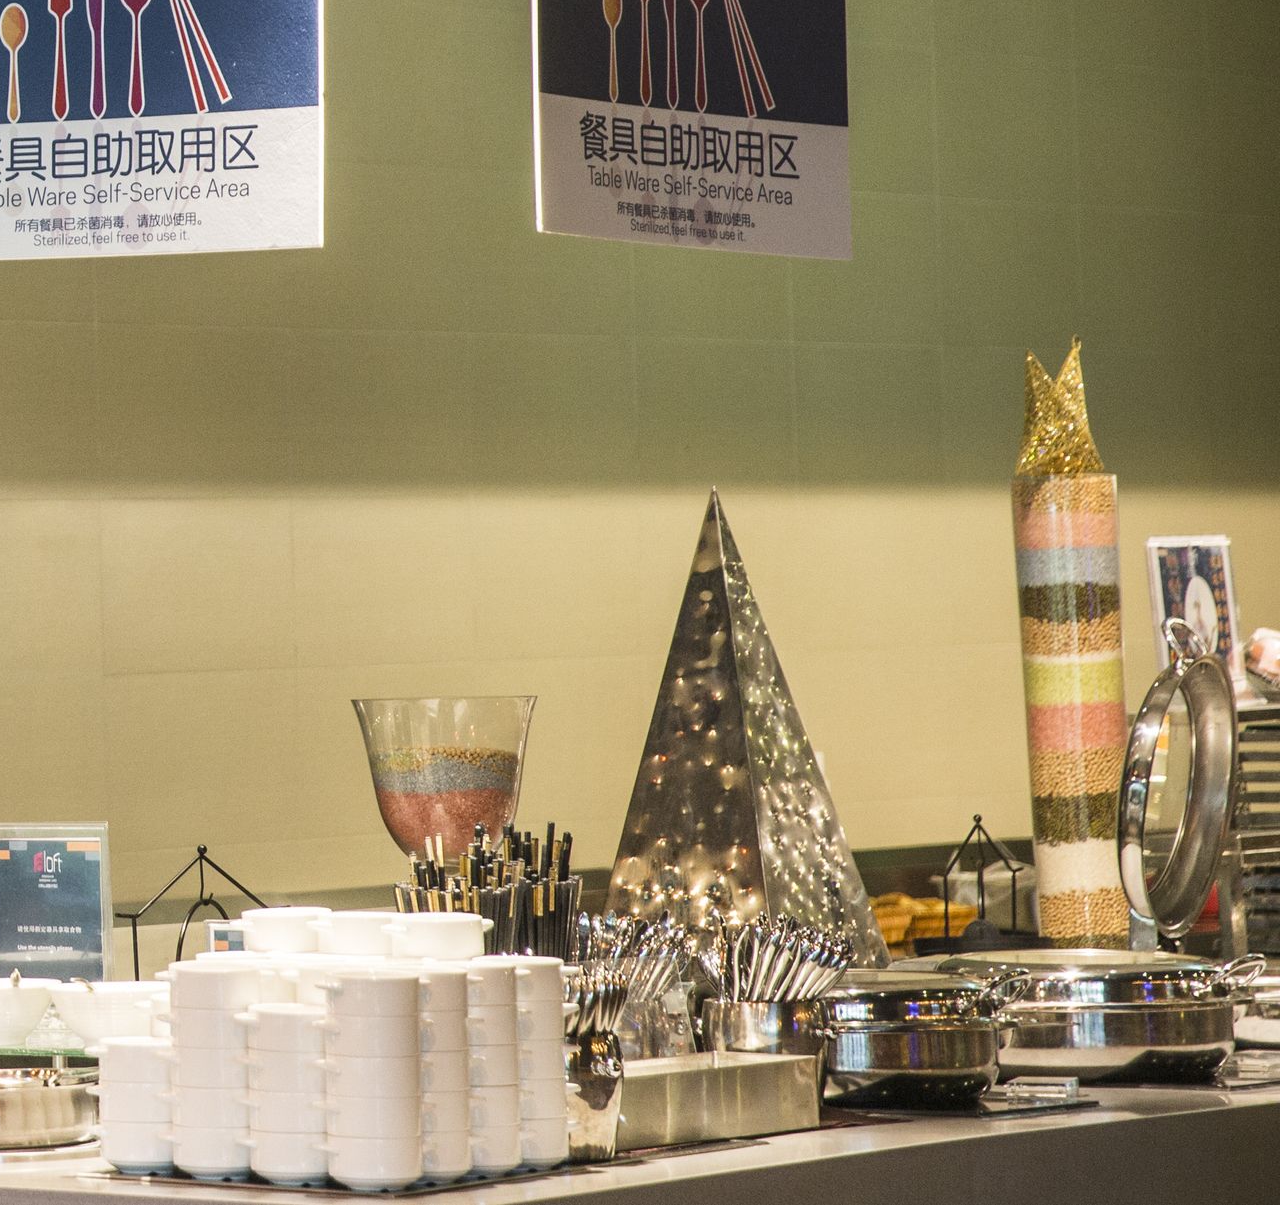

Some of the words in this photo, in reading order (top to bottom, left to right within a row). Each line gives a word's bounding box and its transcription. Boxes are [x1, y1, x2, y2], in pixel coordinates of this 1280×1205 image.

[579, 110, 800, 179] 餐具自助取用区
[27, 186, 77, 206] Ware
[82, 180, 201, 204] Self-Service
[206, 178, 250, 198] Area
[587, 165, 622, 189] Table
[625, 170, 660, 193] Ware
[664, 174, 754, 203] Self-Service
[757, 183, 793, 206] Area
[116, 232, 140, 244] free
[142, 232, 154, 243] to
[156, 232, 177, 242] use
[689, 226, 707, 238] free
[708, 228, 718, 239] to
[719, 229, 736, 241] use
[33, 850, 62, 873] aloft
